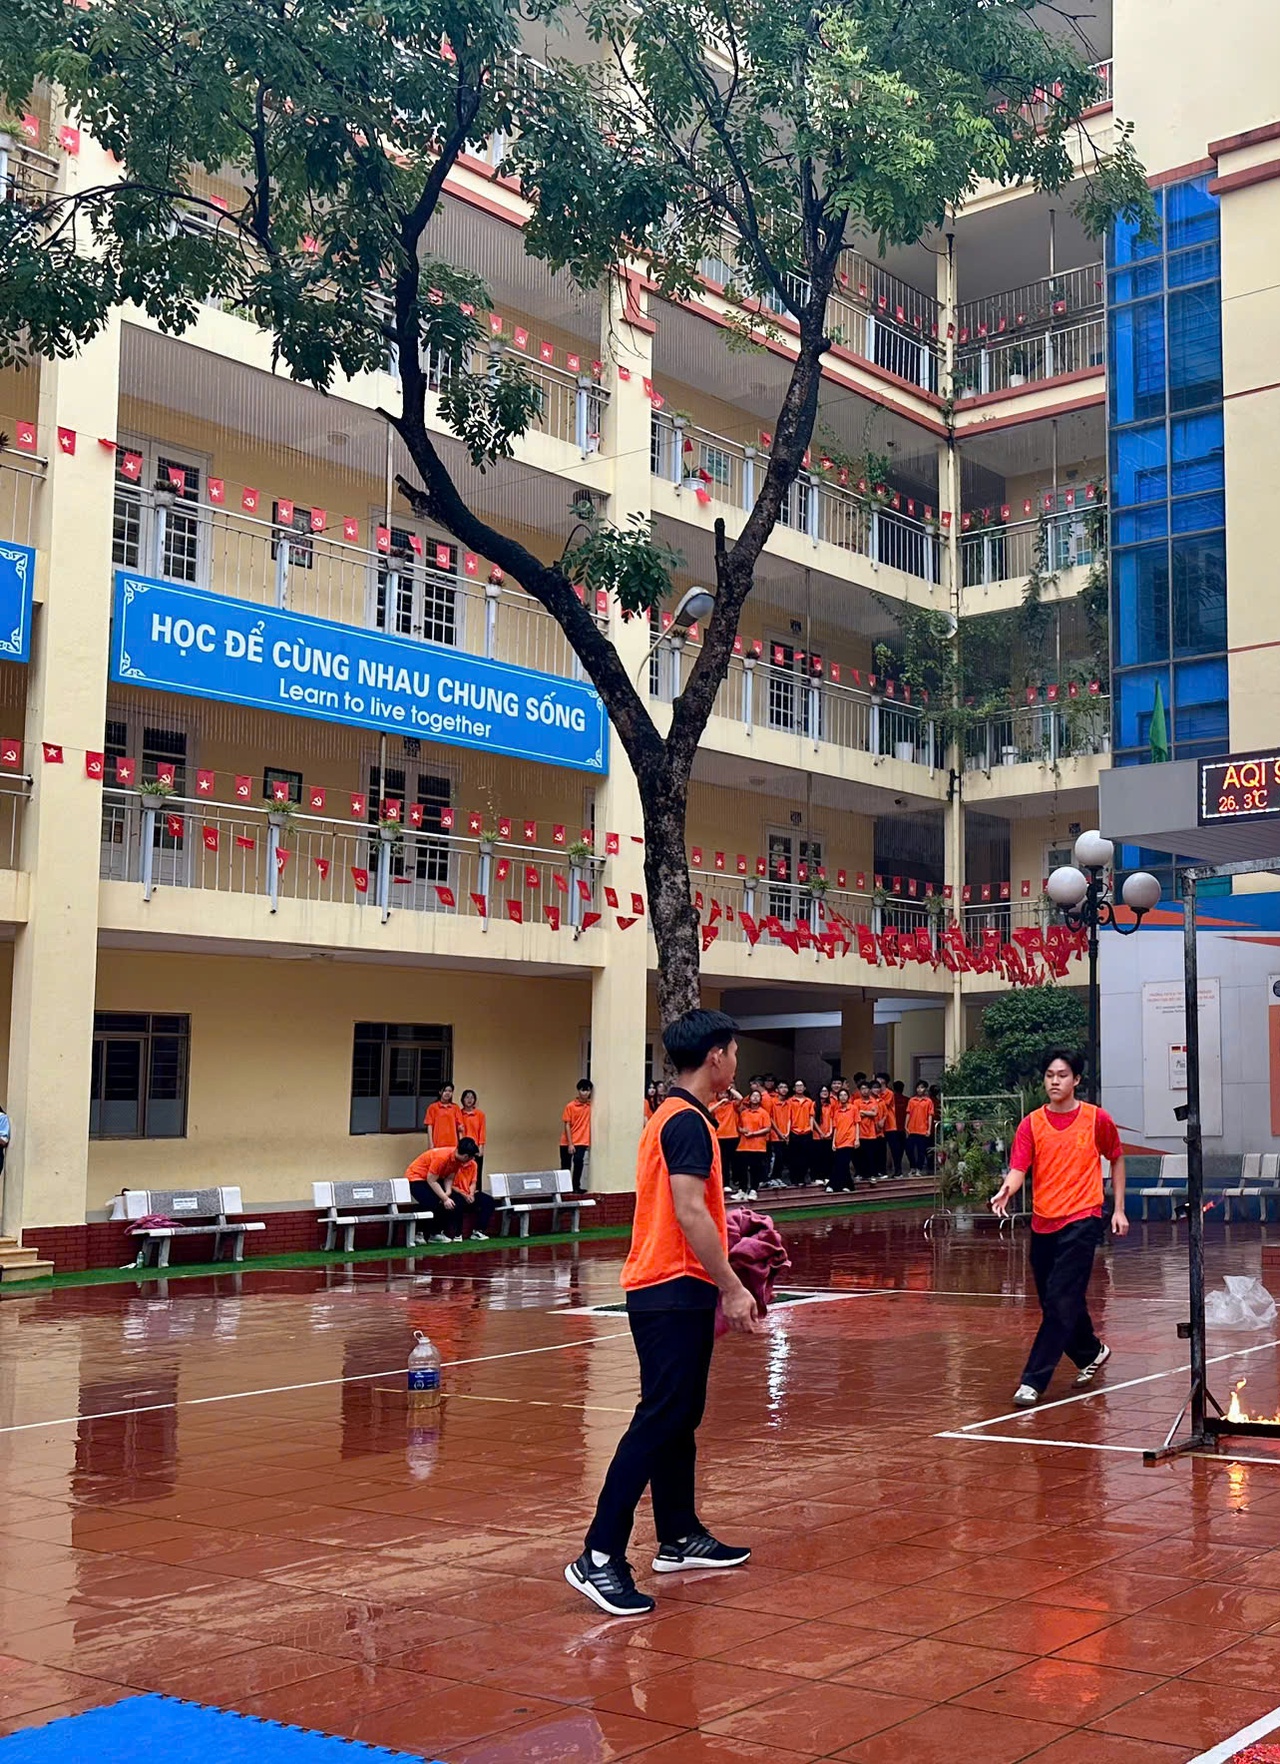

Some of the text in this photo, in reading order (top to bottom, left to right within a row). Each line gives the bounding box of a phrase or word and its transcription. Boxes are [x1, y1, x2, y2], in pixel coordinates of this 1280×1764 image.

[151, 613, 586, 732] HỌC ĐỂ CÙNG NHAU CHUNG SỐNG
[279, 678, 491, 738] Learn to live together
[1222, 762, 1266, 790] AQI
